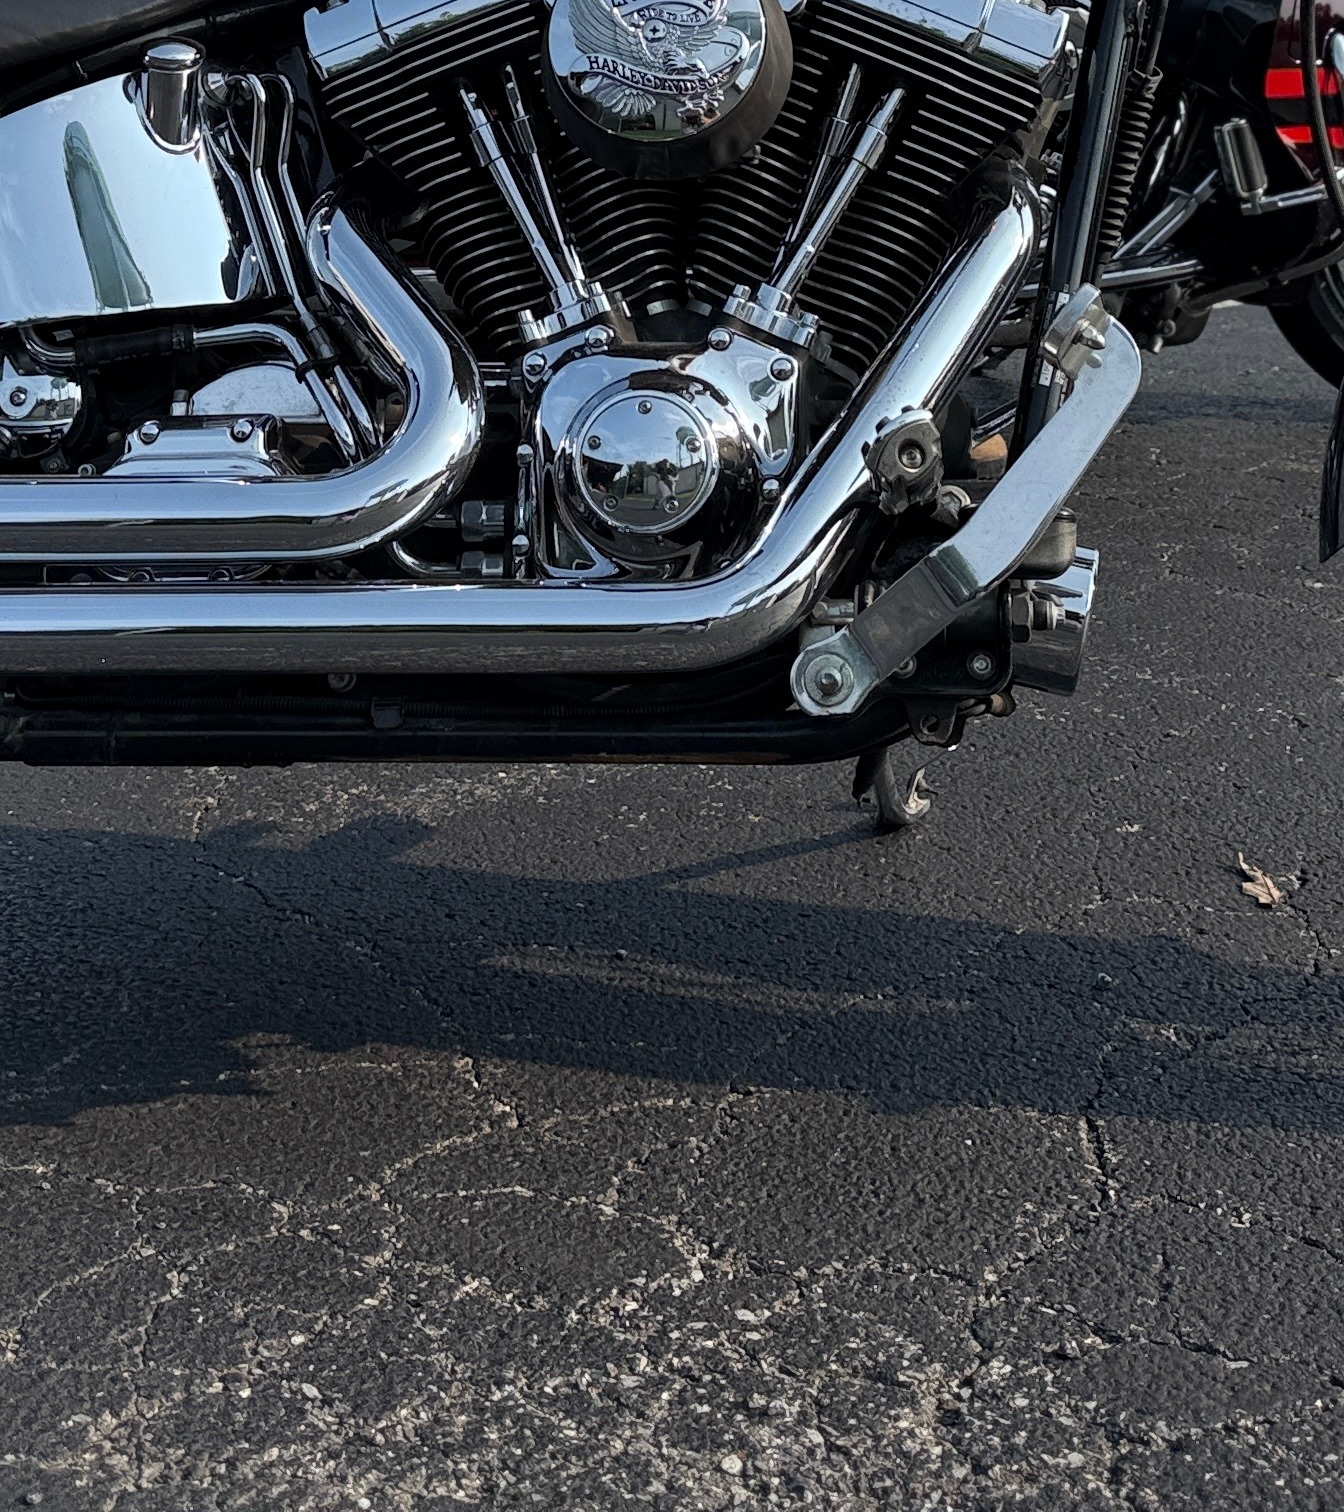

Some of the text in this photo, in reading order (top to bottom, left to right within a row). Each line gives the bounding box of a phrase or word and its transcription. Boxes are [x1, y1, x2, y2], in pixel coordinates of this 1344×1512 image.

[637, 7, 701, 23] RIDE TO LIVE
